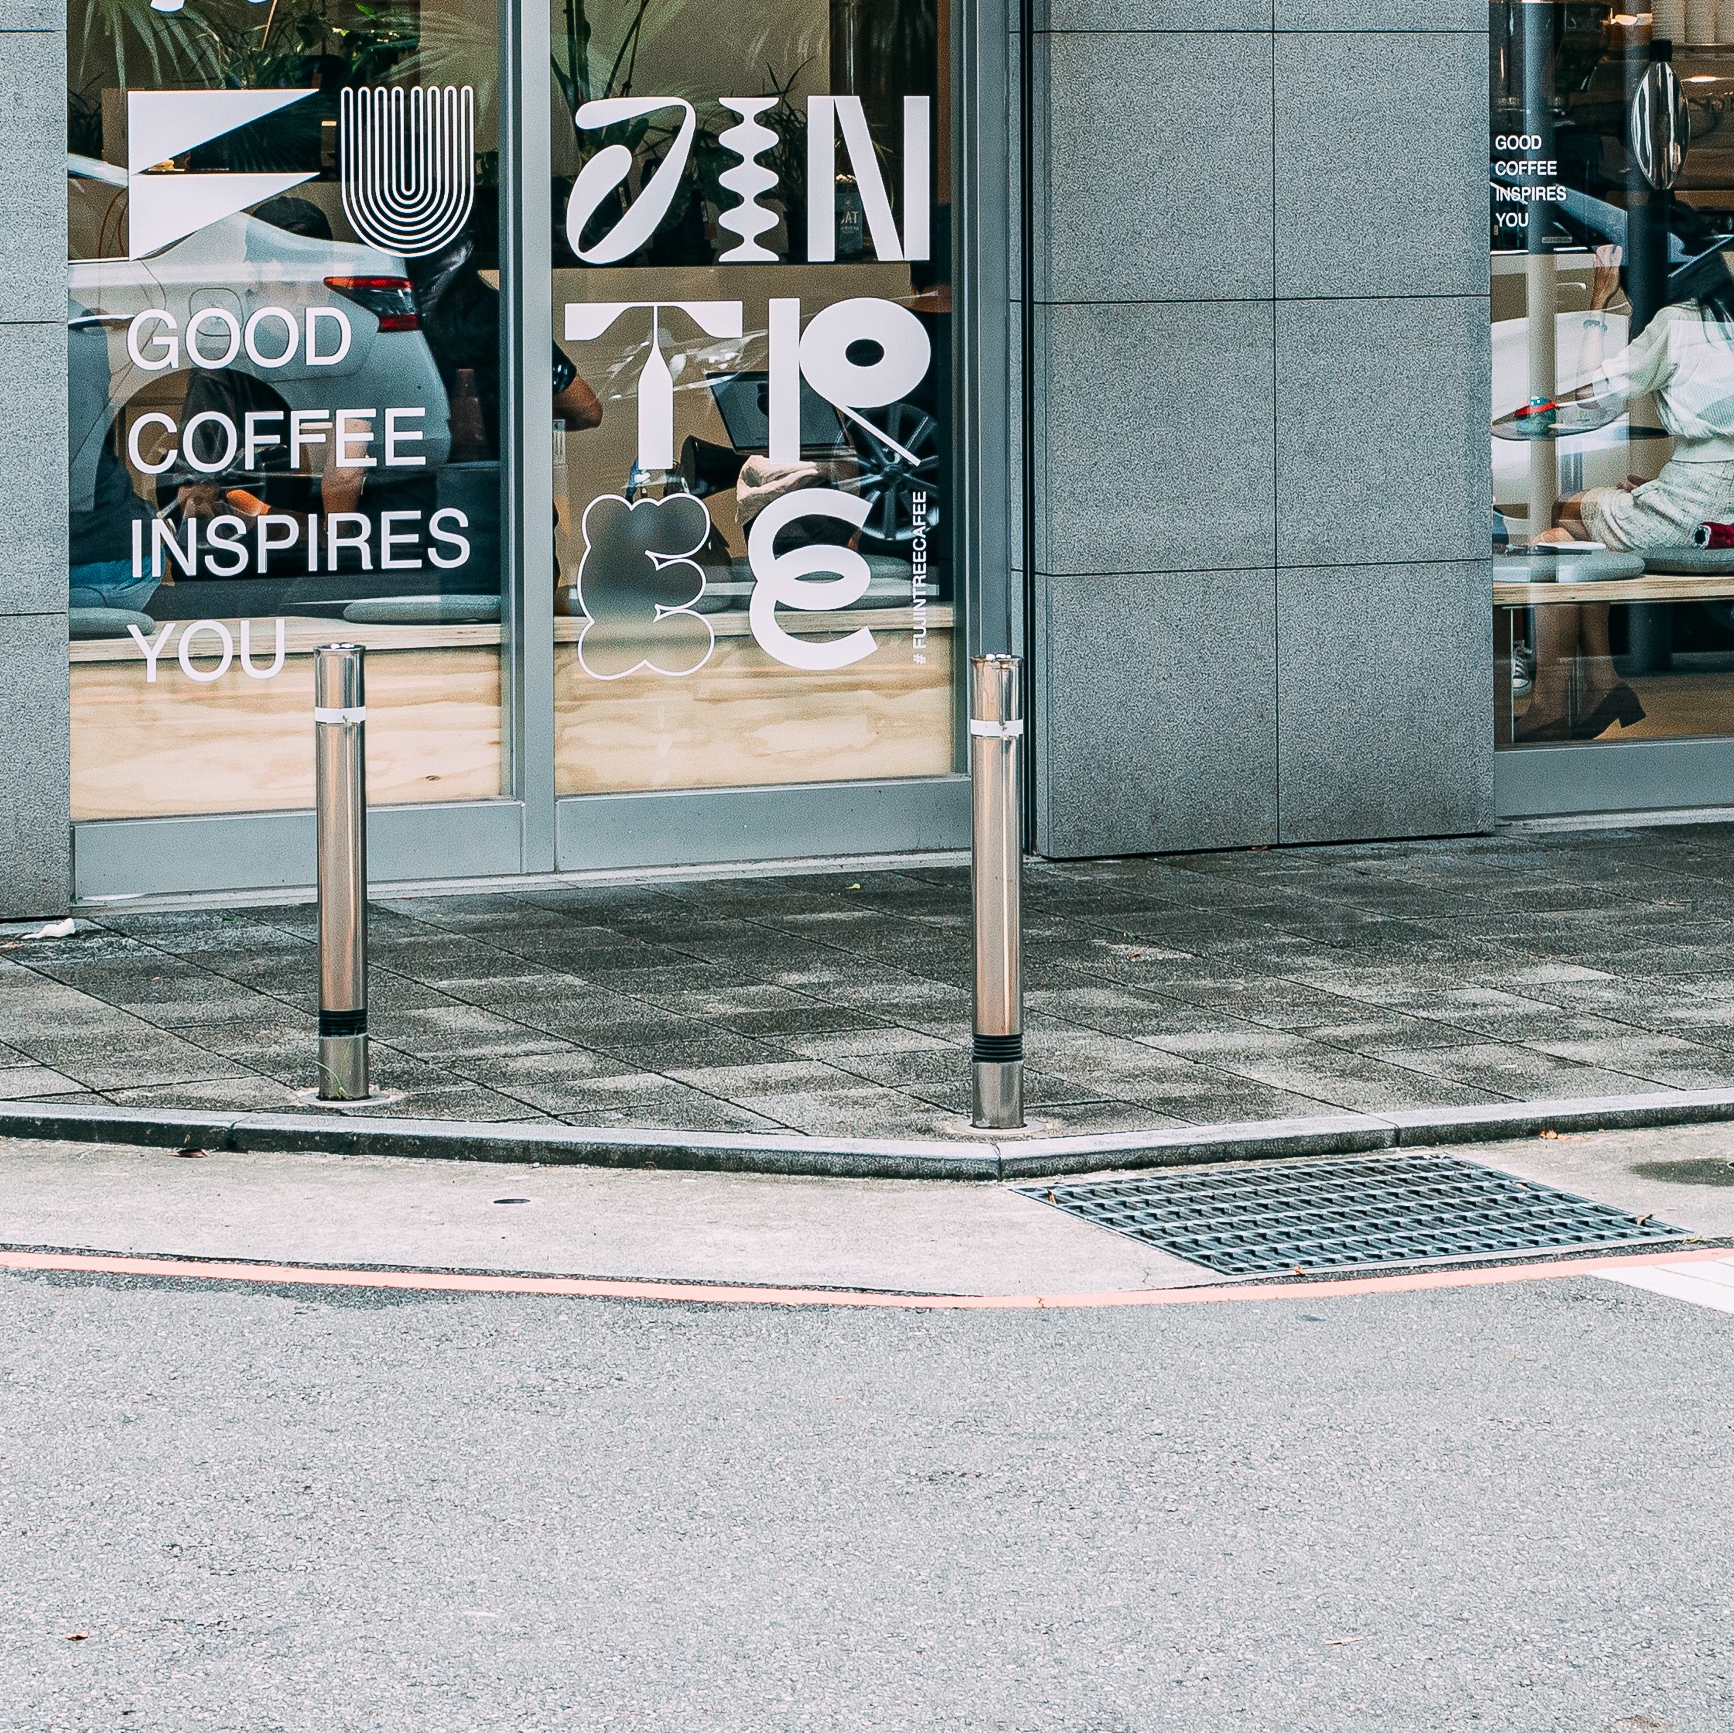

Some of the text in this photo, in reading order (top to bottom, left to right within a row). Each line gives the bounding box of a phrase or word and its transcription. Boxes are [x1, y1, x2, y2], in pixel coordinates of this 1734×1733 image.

[1495, 135, 1542, 150] GOOD
[1495, 161, 1557, 176] COFFEE
[1495, 186, 1567, 201] INSPIRES
[1495, 212, 1529, 228] YOU
[126, 306, 352, 370] GOOD
[126, 406, 426, 475] COFFEE
[129, 507, 470, 579] INSPIRES
[912, 490, 927, 665] # FUJINTREECAFEE
[126, 619, 287, 684] YOU
